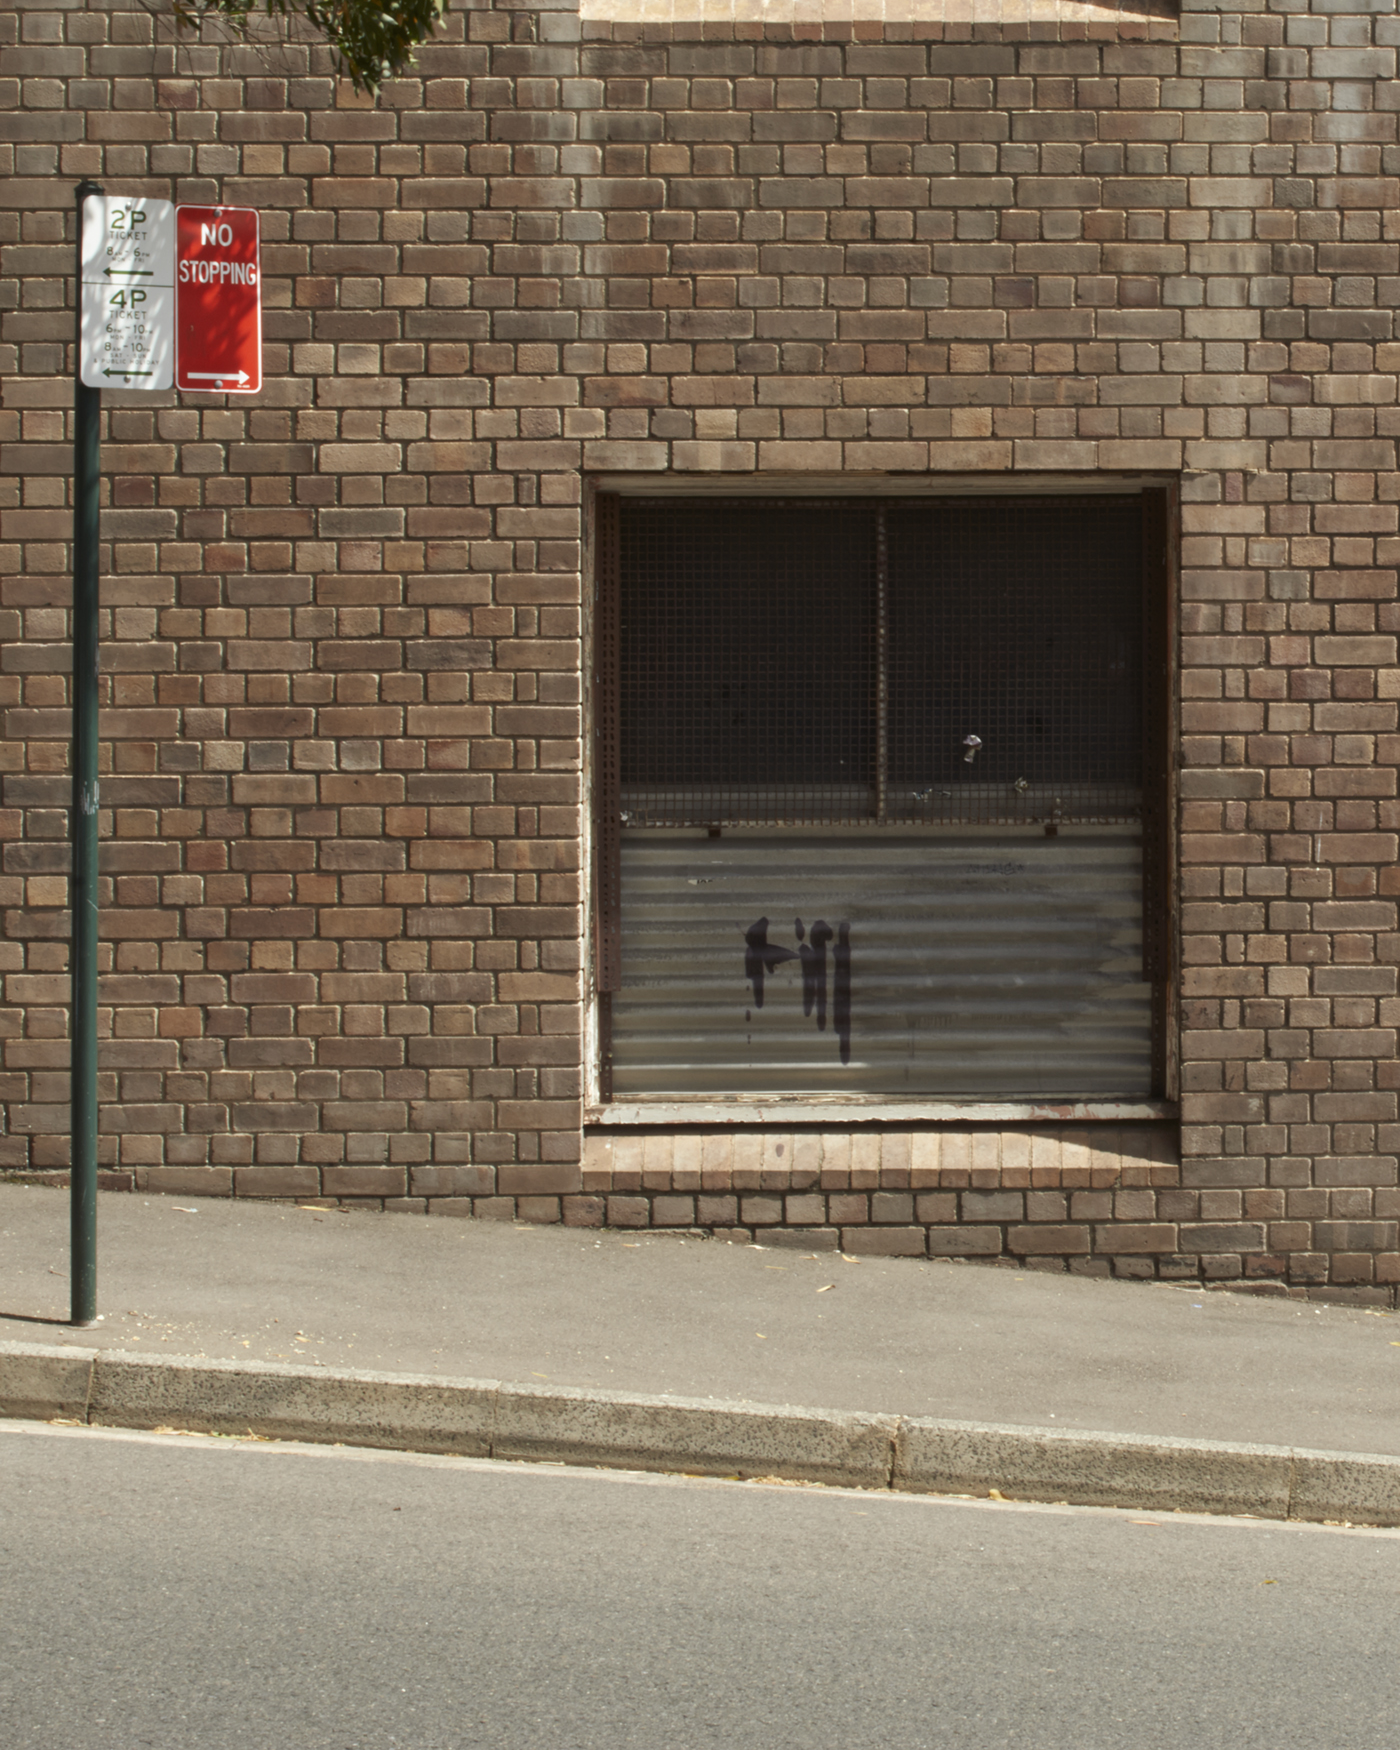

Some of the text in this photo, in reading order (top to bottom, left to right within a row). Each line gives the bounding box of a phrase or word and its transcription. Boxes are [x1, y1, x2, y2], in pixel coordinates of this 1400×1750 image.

[111, 210, 146, 230] 2P
[110, 231, 147, 240] TICKET
[201, 223, 233, 247] NO
[179, 260, 256, 285] STOPPING
[109, 289, 147, 309] 4P
[109, 310, 147, 320] TICKET
